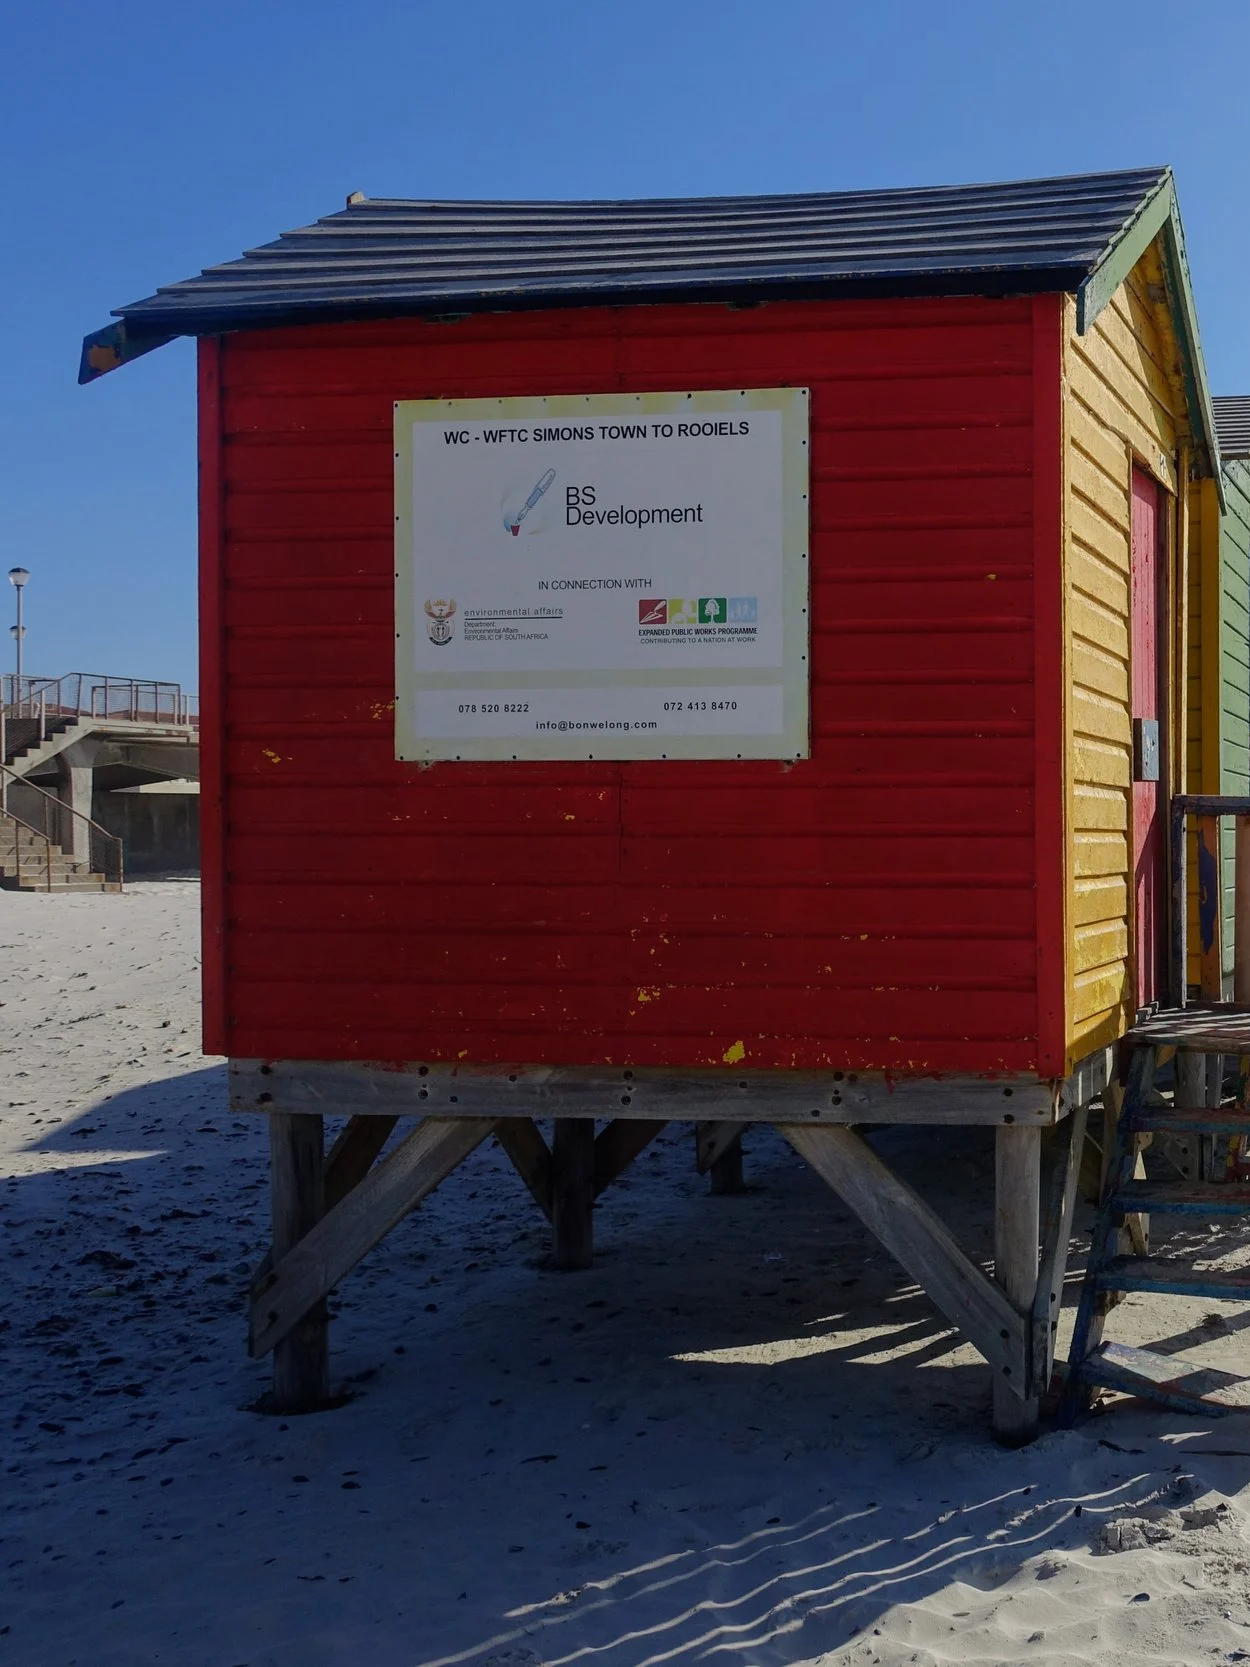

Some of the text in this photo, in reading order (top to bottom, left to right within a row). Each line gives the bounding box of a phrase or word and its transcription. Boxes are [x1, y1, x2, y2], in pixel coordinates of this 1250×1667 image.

[444, 431, 470, 444] WC
[483, 429, 529, 443] WFTC
[533, 427, 594, 442] SIMONS
[599, 425, 647, 439] TOWN
[652, 424, 673, 438] TO
[678, 421, 749, 437] ROOIELS
[566, 486, 596, 506] BS
[566, 504, 703, 529] Development
[538, 578, 652, 590] IN CONNECTION WITH
[464, 607, 564, 617] environmental affairs
[504, 633, 526, 641] SOUTH
[638, 626, 759, 637] EXPANDED PUBLIC WORKS PROGRAMME
[640, 637, 687, 645] CONTRIBUTING
[697, 636, 702, 644] A
[736, 635, 756, 643] WORK
[458, 703, 530, 713] 078 520 8222
[663, 701, 738, 711] 072 413 8470
[535, 720, 657, 732] info@bonwelong.com
